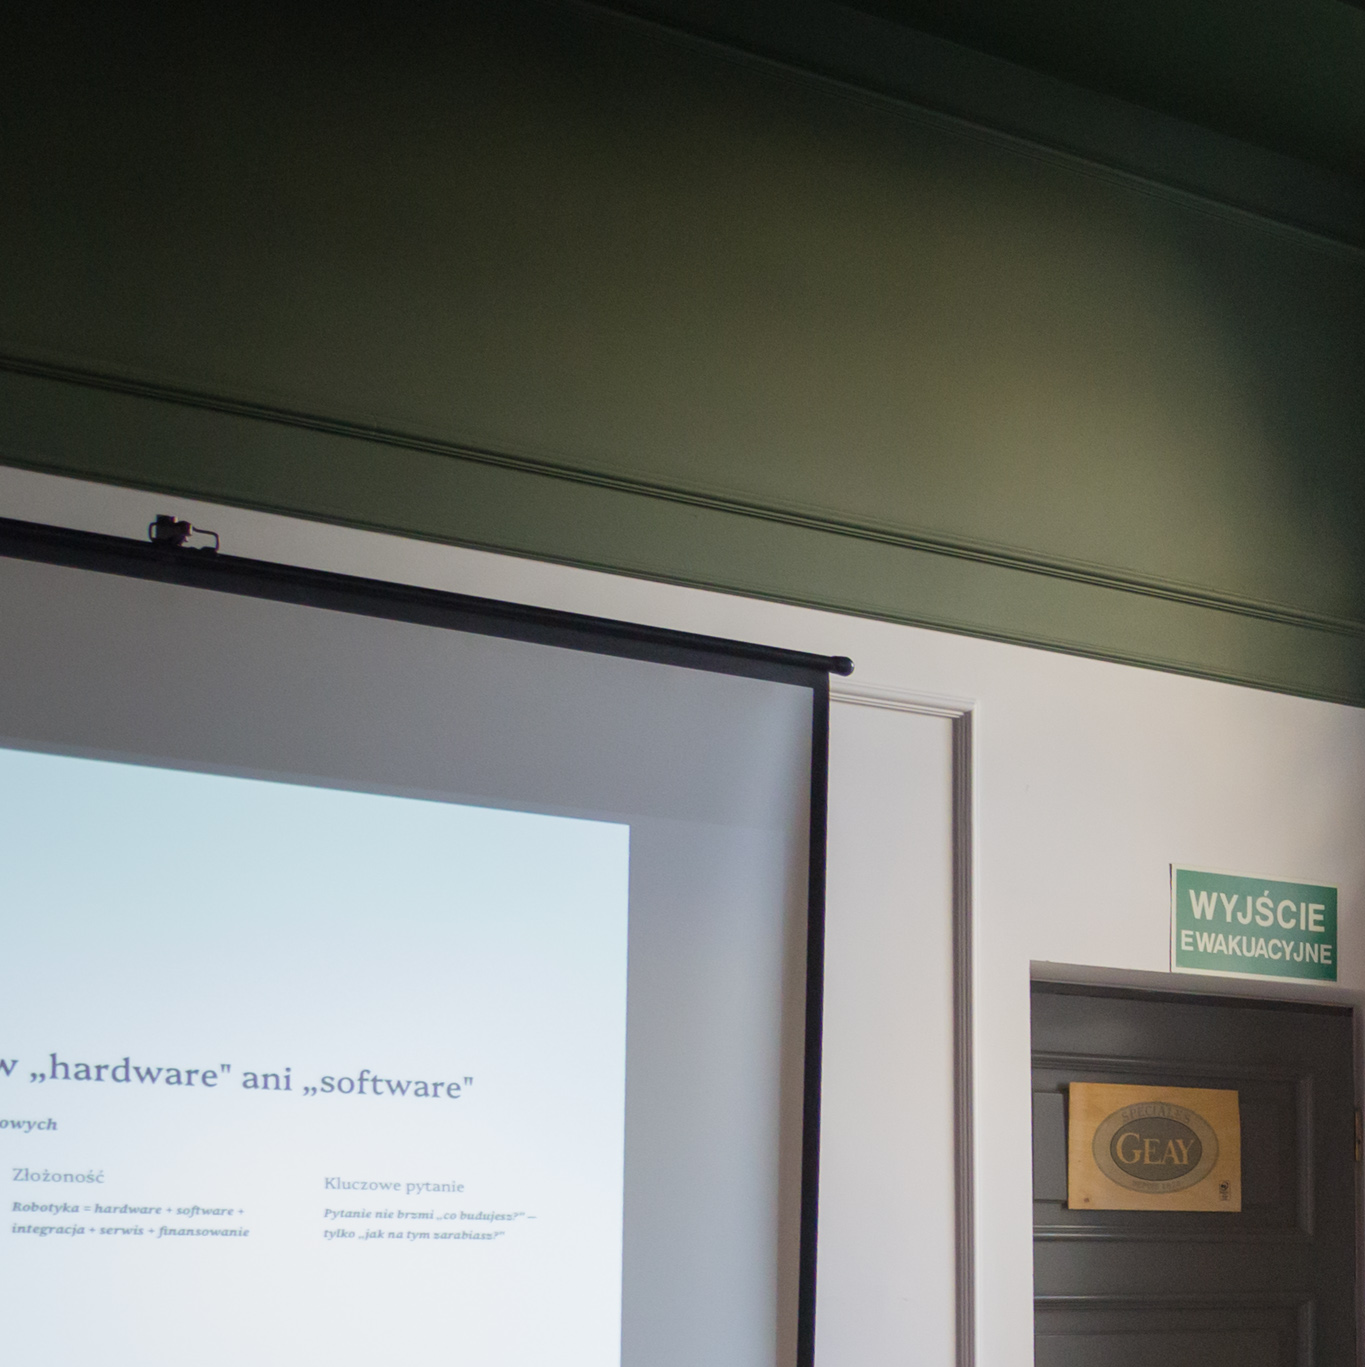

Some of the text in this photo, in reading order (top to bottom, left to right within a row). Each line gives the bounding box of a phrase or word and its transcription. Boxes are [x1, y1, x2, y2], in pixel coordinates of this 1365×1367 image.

[1189, 889, 1326, 933] WYJŚCIE
[1180, 929, 1333, 965] EWAKUACYJNE
[242, 1067, 293, 1091] ani
[1116, 1132, 1197, 1165] GEAY
[12, 1167, 105, 1184] Złożoność
[324, 1177, 465, 1195] Kluczowe pytanie
[12, 1202, 80, 1215] Robotyka
[95, 1203, 162, 1215] hardware
[176, 1205, 234, 1218] software
[324, 1208, 372, 1221] Pytanie
[374, 1210, 394, 1219] nie
[397, 1210, 434, 1220] brzmi
[12, 1223, 85, 1238] integracja
[99, 1225, 144, 1236] serwis
[157, 1225, 250, 1239] finansowanie
[324, 1229, 355, 1241] tylko
[387, 1231, 404, 1239] na
[406, 1231, 430, 1241] tym
